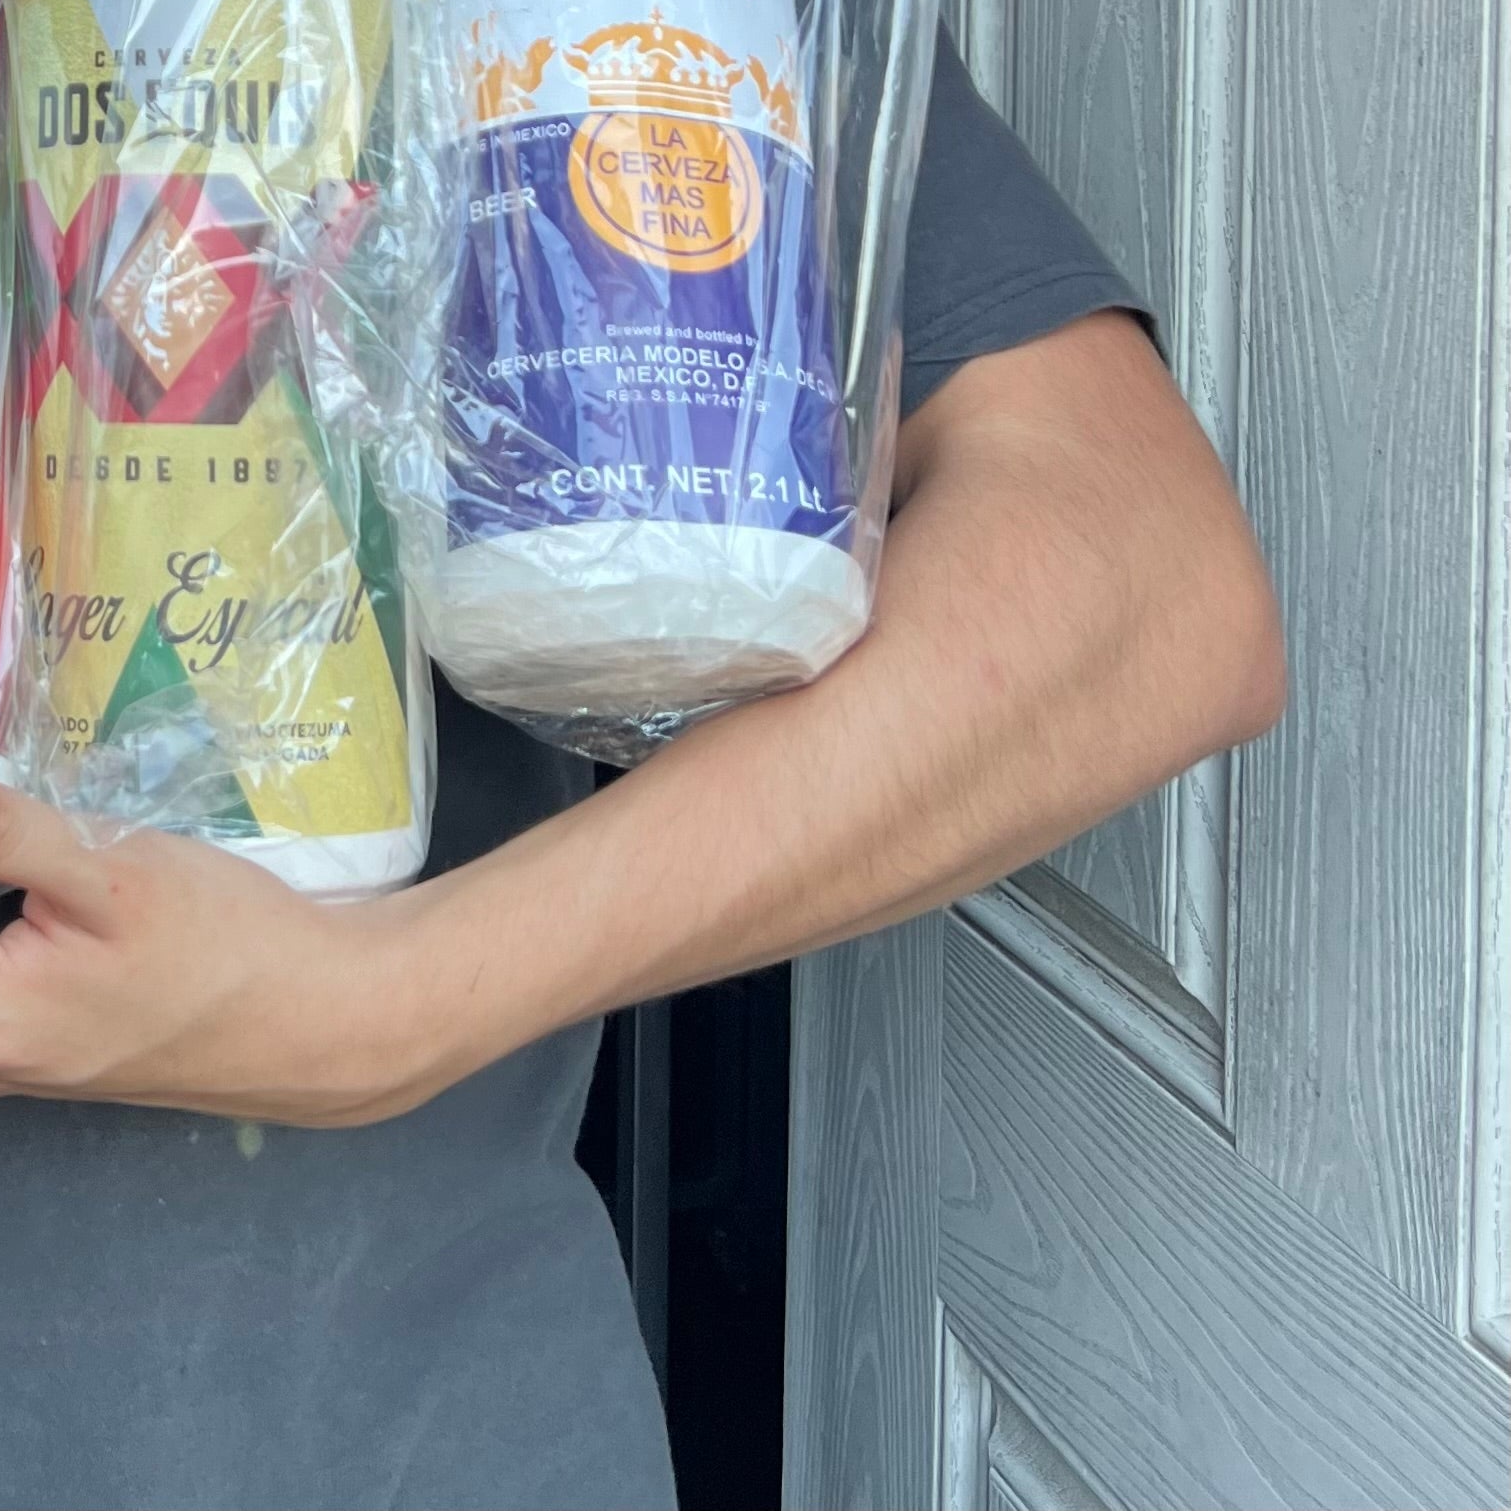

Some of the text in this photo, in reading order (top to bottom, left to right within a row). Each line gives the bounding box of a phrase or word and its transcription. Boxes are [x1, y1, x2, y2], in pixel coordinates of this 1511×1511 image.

[38, 79, 126, 149] DOS
[650, 123, 688, 151] LA
[597, 150, 739, 188] CERVEZA
[469, 186, 537, 223] BEER
[640, 181, 705, 210] MAS
[641, 209, 713, 240] FINA
[665, 325, 692, 339] and
[486, 344, 638, 380] CERVECERIA
[550, 463, 656, 497] CONT.
[748, 471, 790, 504] 2.1
